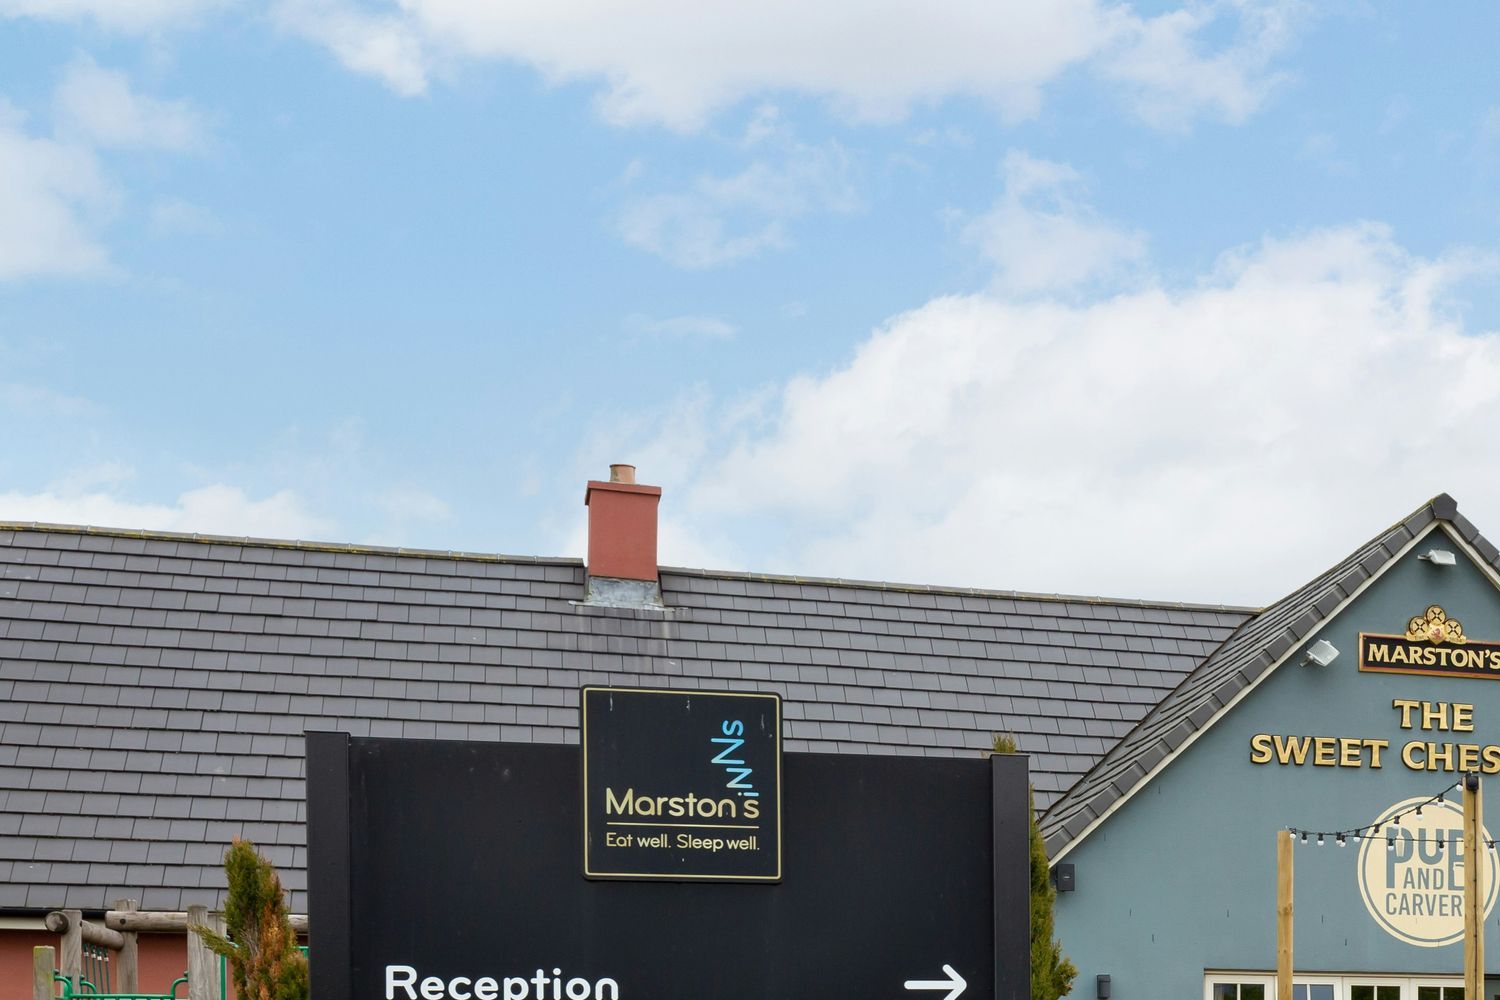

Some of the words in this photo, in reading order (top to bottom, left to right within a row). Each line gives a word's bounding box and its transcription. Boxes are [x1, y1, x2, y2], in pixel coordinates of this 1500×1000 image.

[1392, 699, 1475, 732] THE
[1250, 734, 1389, 768] SWEET
[606, 832, 633, 848] Eat
[636, 833, 671, 849] well.
[676, 833, 724, 853] Sleep
[726, 835, 760, 851] well.
[1403, 866, 1445, 891] AND
[1385, 892, 1466, 918] CARVER
